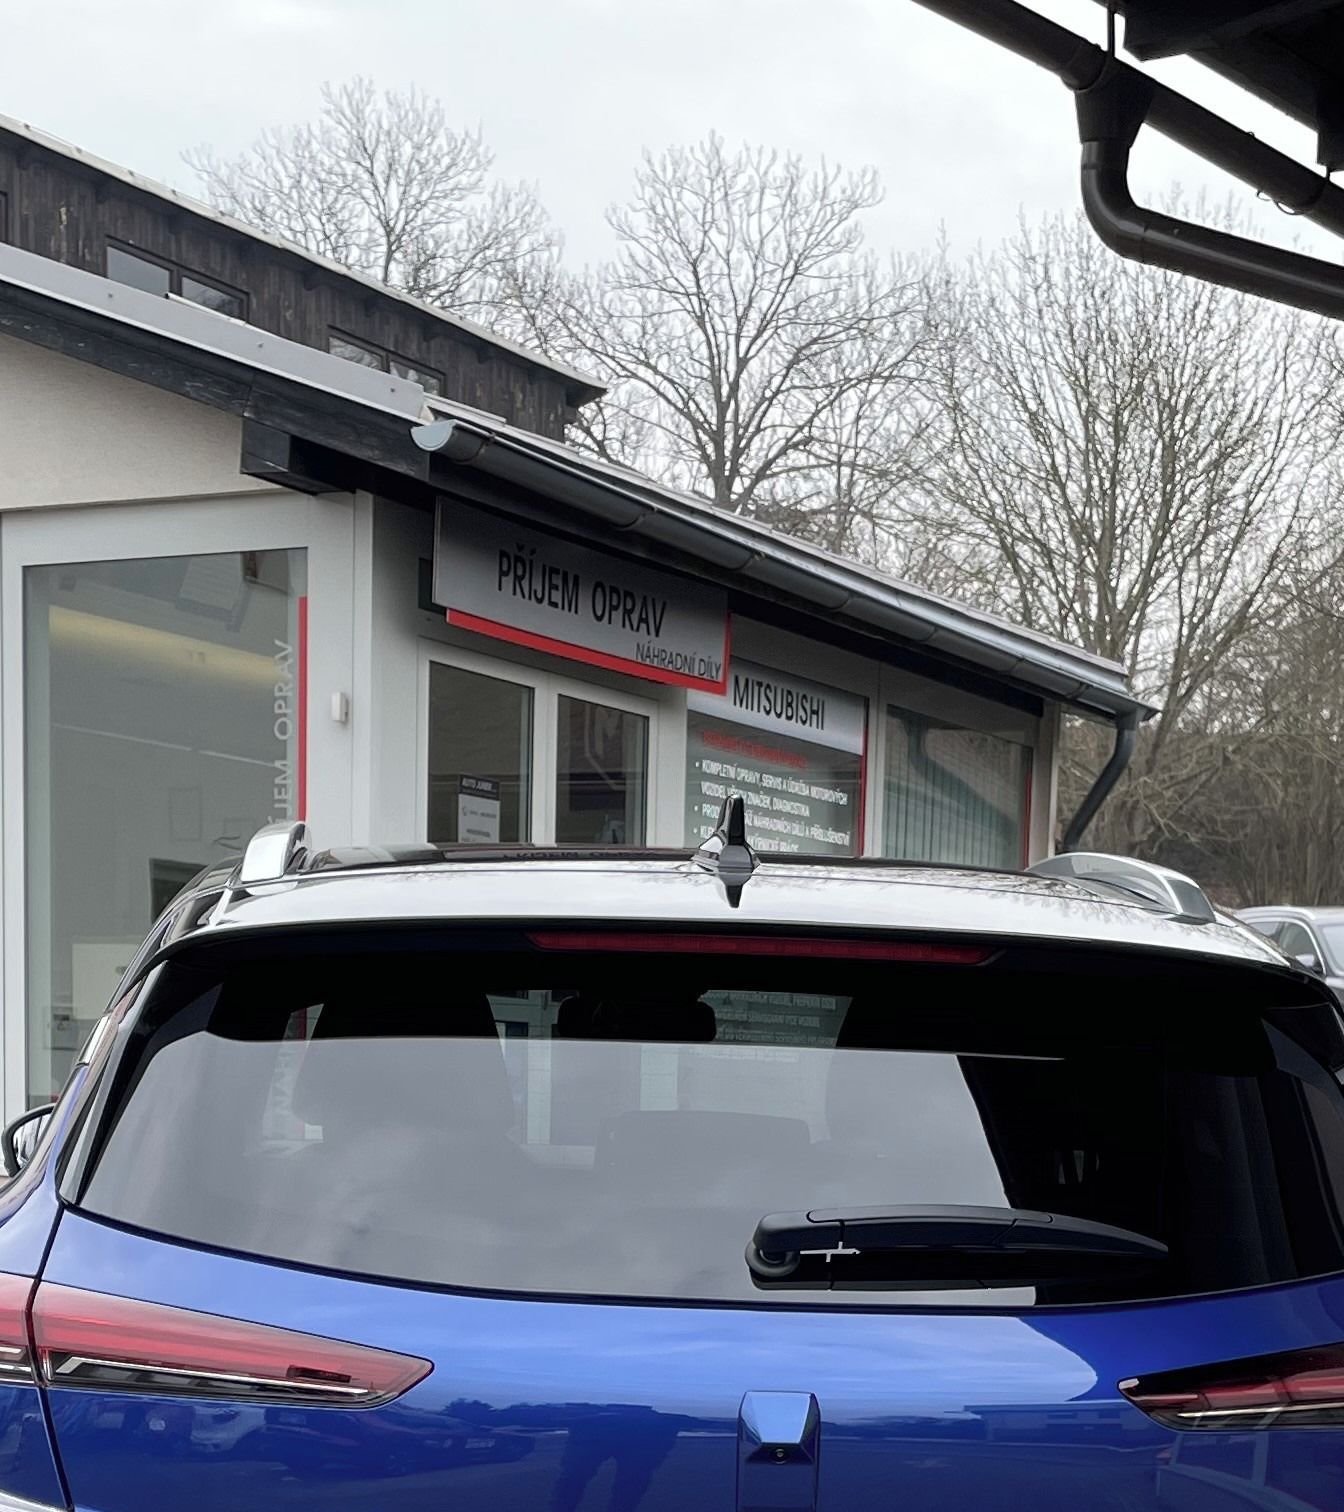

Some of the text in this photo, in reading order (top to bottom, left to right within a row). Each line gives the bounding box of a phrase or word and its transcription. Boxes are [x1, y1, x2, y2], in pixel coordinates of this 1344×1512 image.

[497, 542, 667, 638] PŘÍJEM OPRAV
[274, 638, 293, 741] OPRAV
[635, 640, 722, 681] NÁHRADNÍ DÍLY
[733, 675, 825, 730] MITSUBISHI
